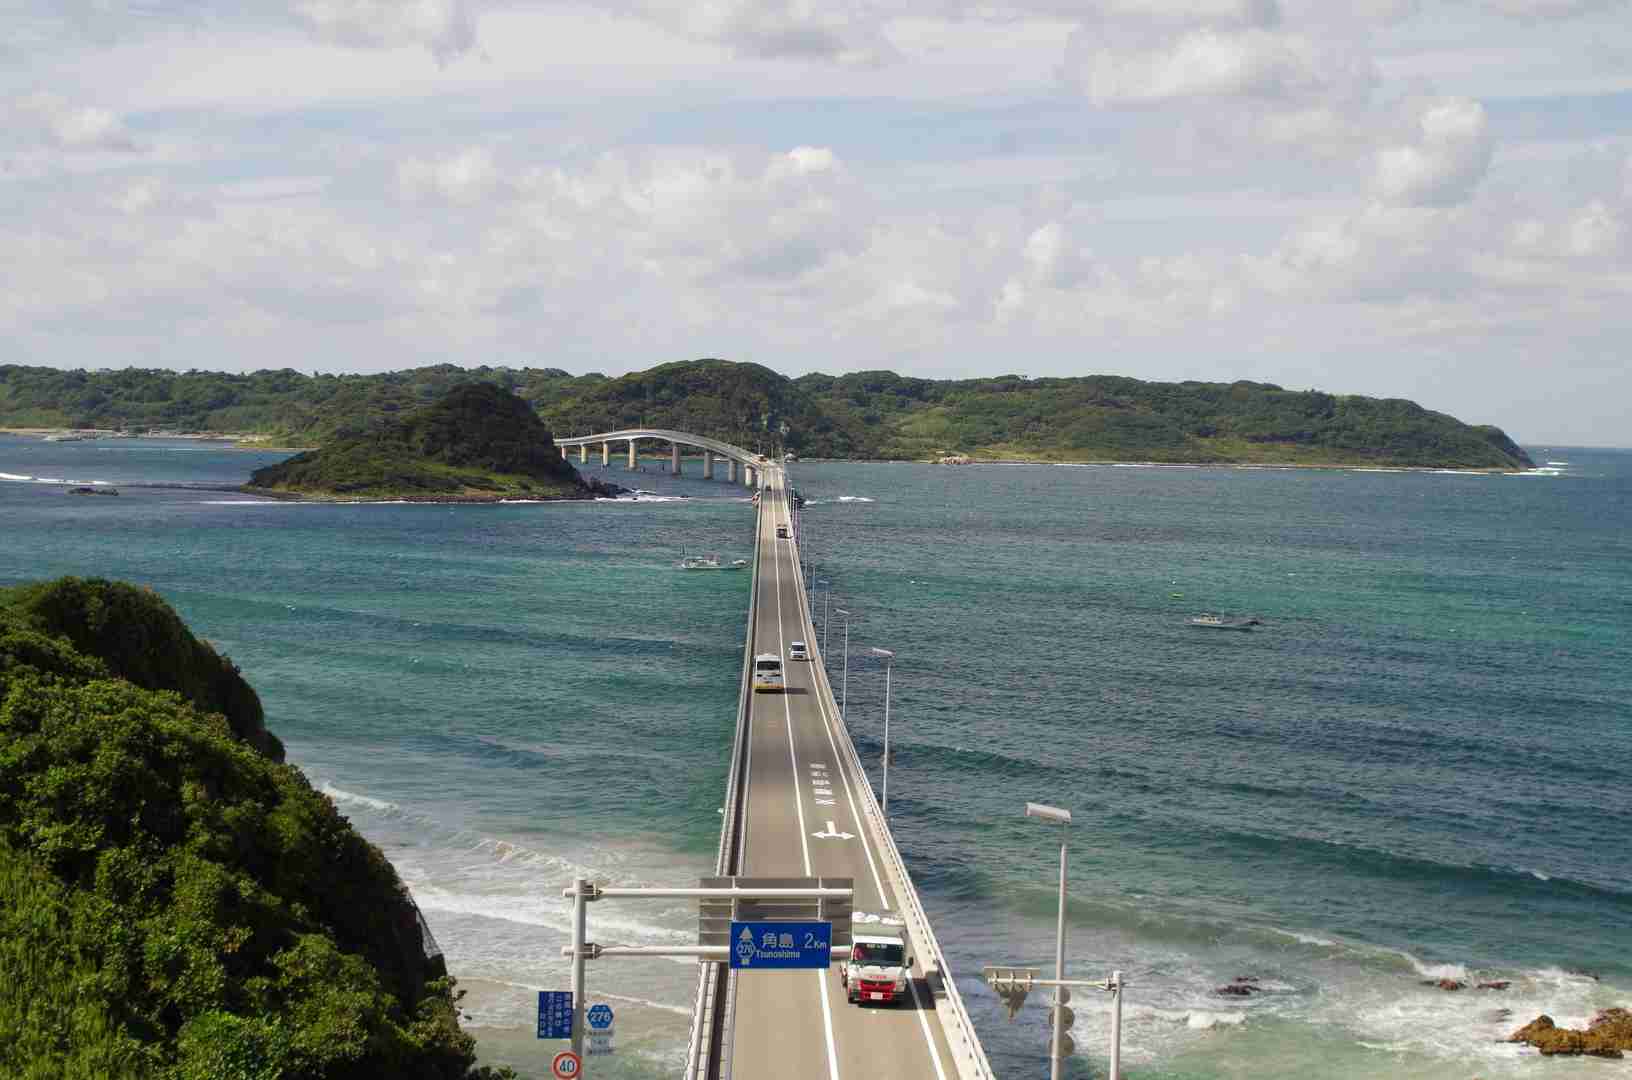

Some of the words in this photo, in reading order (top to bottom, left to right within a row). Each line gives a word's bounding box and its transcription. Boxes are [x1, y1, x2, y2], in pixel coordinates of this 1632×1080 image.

[762, 932, 794, 949] 角島
[756, 950, 801, 959] Tsunoshima
[560, 1060, 576, 1072] 40
